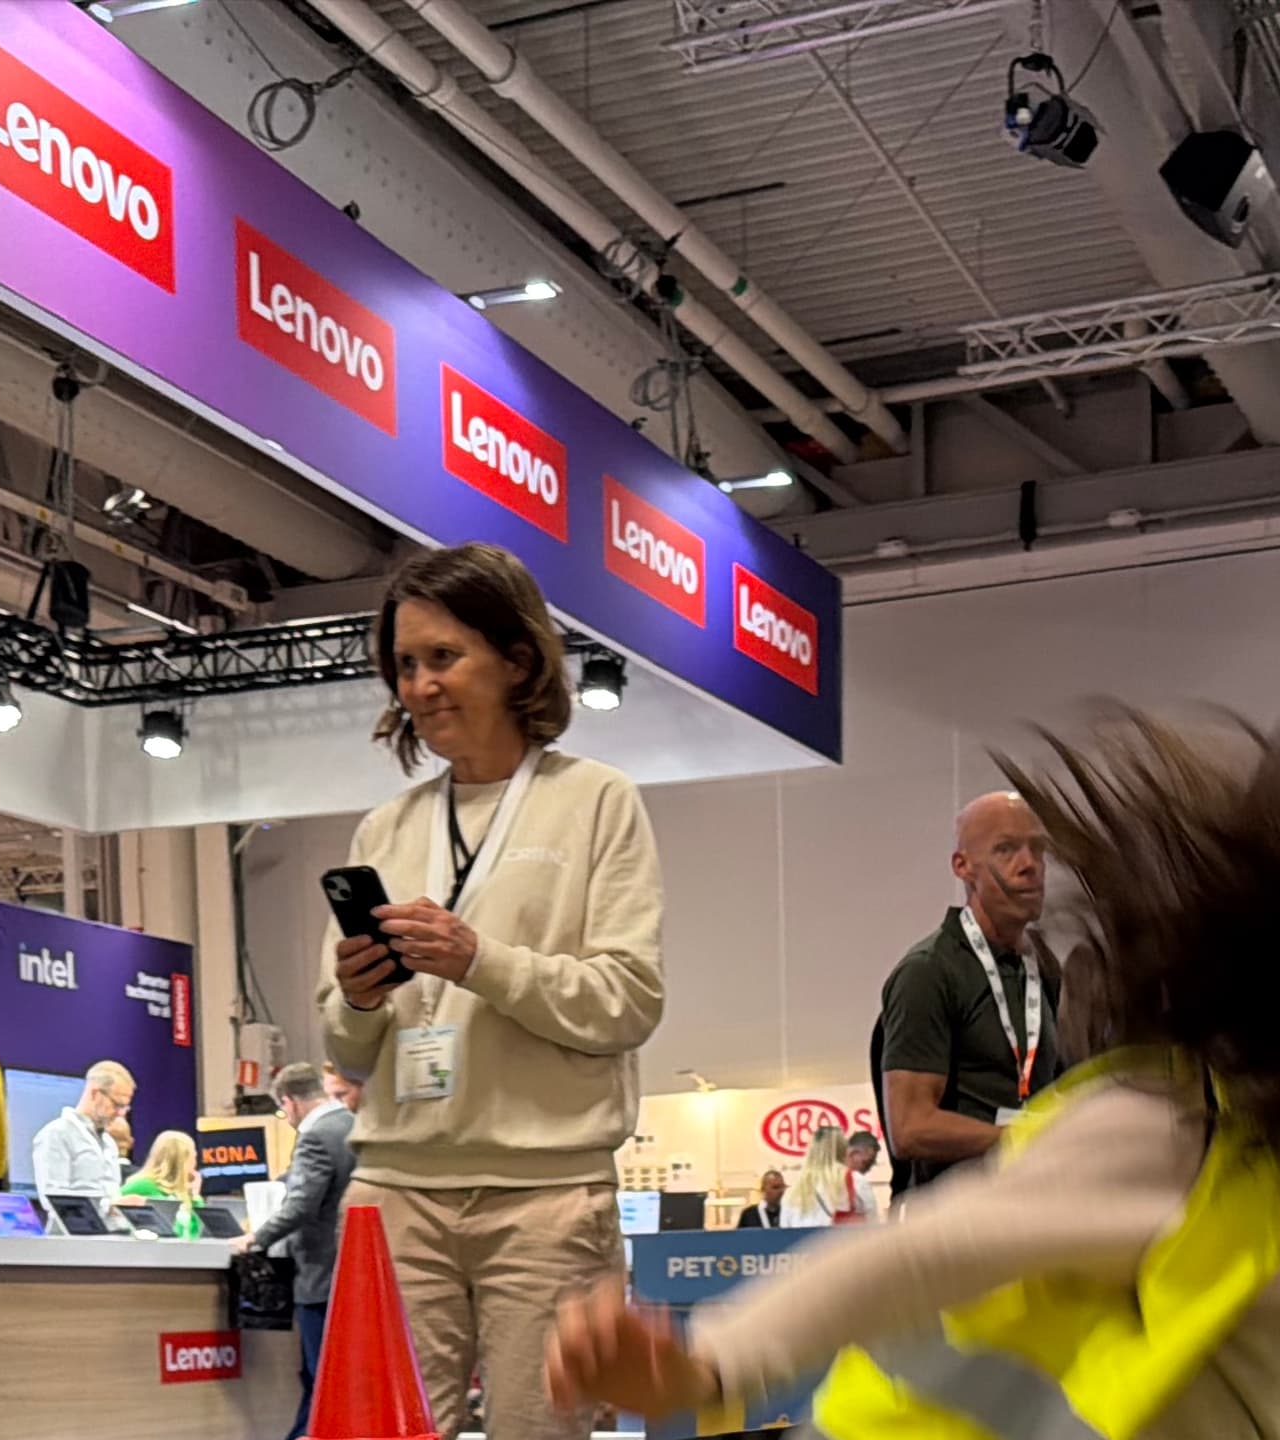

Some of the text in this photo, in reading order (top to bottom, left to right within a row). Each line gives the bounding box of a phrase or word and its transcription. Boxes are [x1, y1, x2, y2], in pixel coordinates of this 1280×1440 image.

[249, 251, 385, 392] Lenovo
[451, 390, 558, 506] Lenovo
[611, 499, 699, 596] Lenovo
[738, 584, 812, 666] Lenovo
[19, 942, 77, 990] intel
[202, 1144, 258, 1165] KONA
[666, 1255, 716, 1279] PET
[164, 1342, 237, 1372] Lenovo
